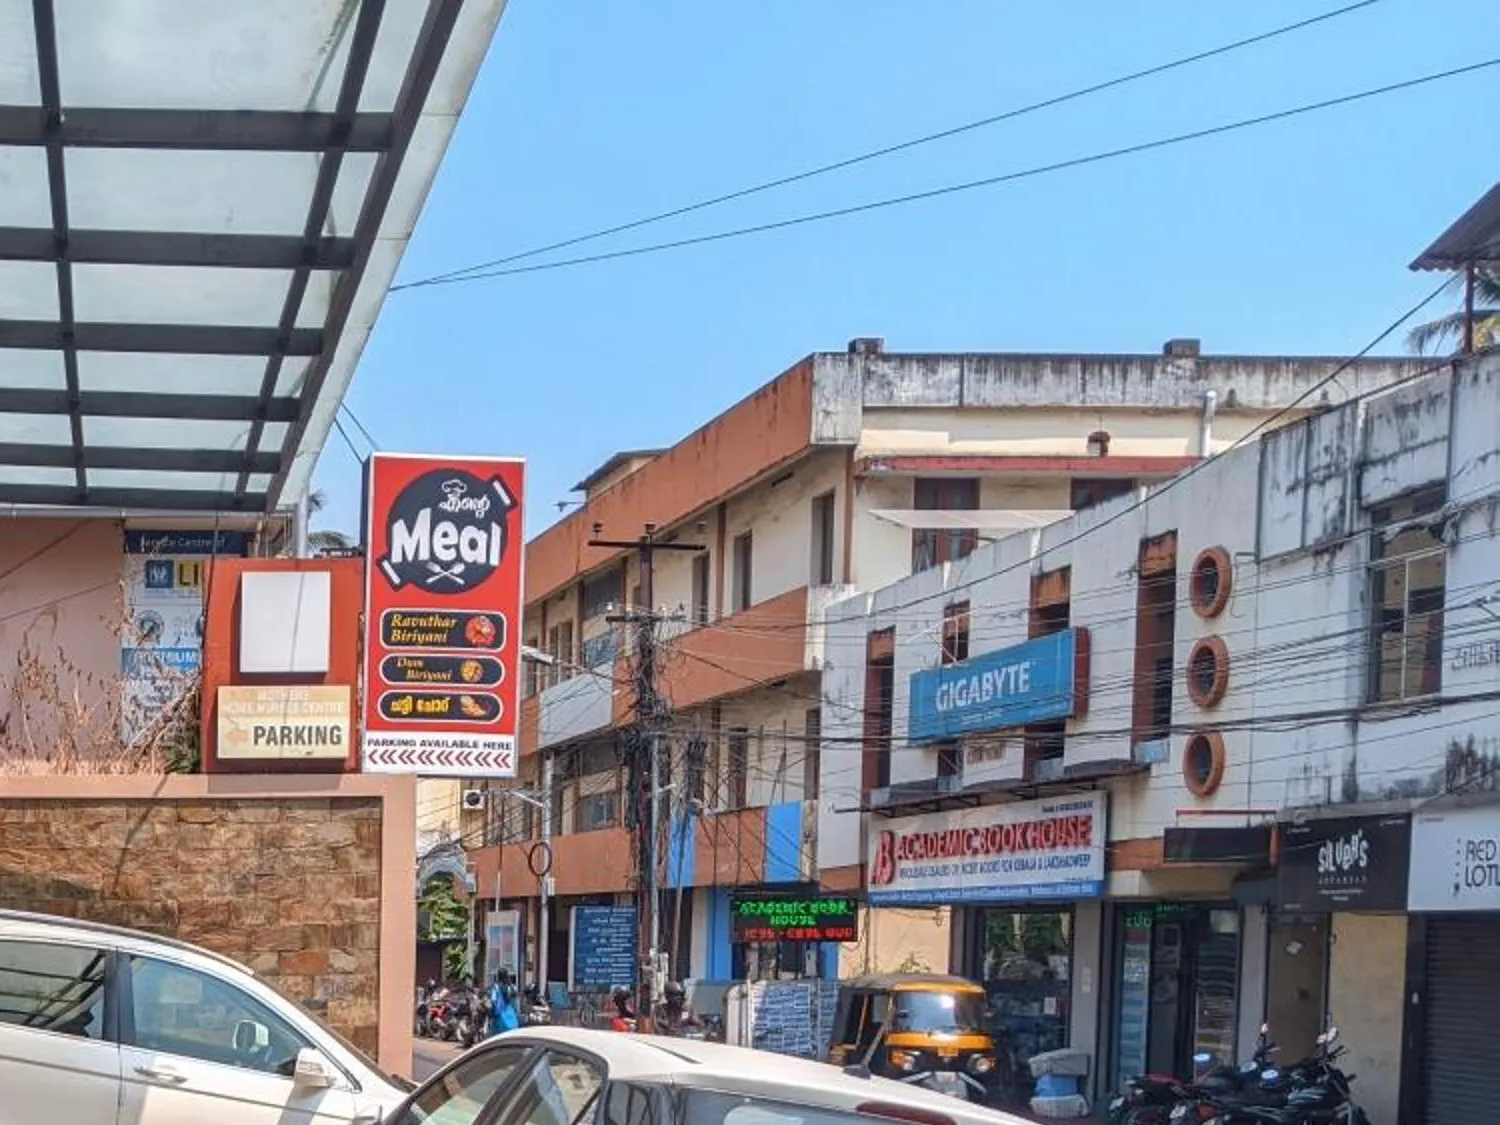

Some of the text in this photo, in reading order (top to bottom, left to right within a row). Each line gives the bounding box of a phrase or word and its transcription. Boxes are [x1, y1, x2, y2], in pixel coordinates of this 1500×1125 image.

[390, 507, 501, 567] Meal
[390, 629, 449, 645] Biriyani
[935, 660, 1031, 712] GIGABYTE
[252, 725, 342, 747] PARKING
[367, 738, 513, 751] PARKING AVAILABLE HERE
[896, 814, 1093, 860] ACADEMIC BOOK HOUSE
[1465, 839, 1497, 862] RED
